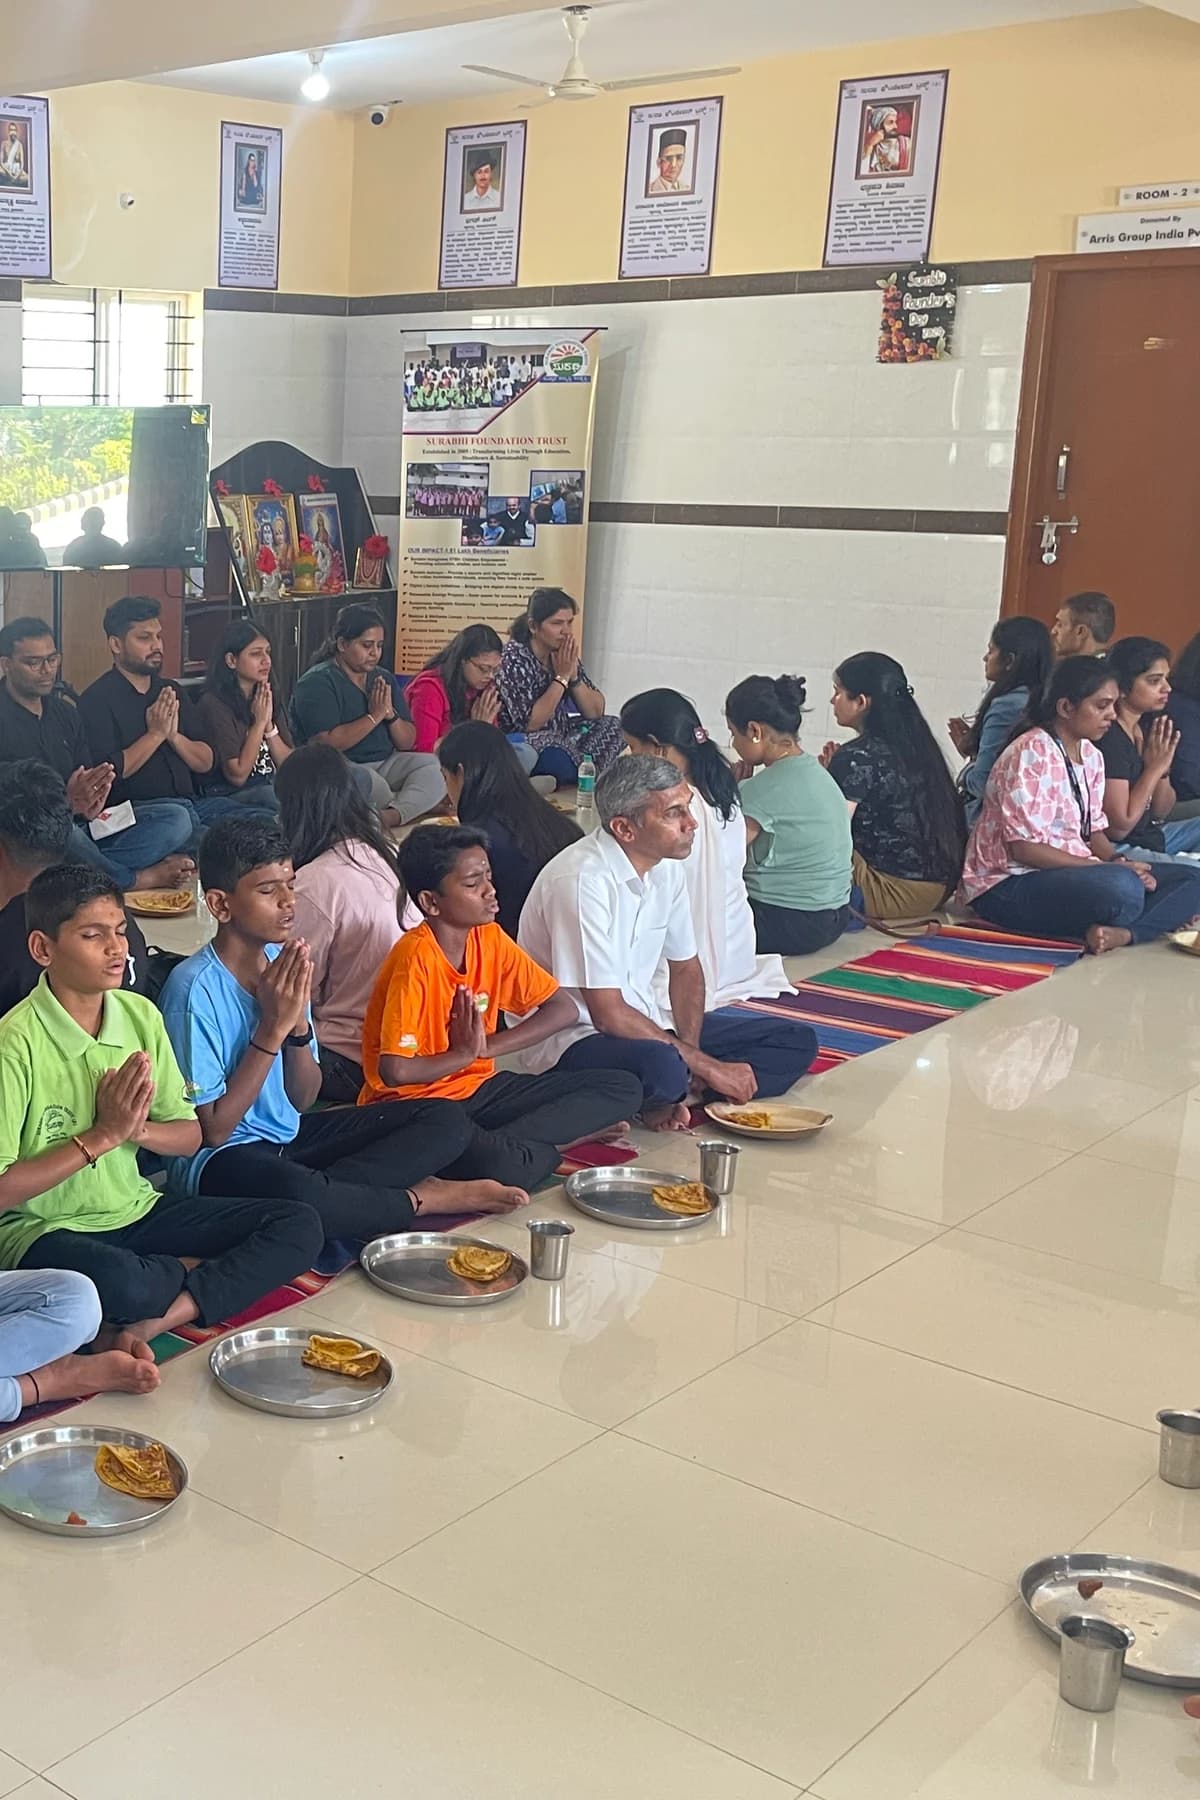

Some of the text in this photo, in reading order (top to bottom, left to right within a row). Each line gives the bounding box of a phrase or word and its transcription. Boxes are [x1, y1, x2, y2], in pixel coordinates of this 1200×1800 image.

[1136, 190, 1169, 200] ROOM
[1181, 188, 1188, 197] 2
[1140, 216, 1171, 224] Donated
[1089, 234, 1115, 244] Arris
[1118, 232, 1152, 243] Group
[1156, 229, 1184, 240] India
[909, 311, 929, 327] Day
[426, 437, 568, 445] SURABHI FOUNDATION TRUST
